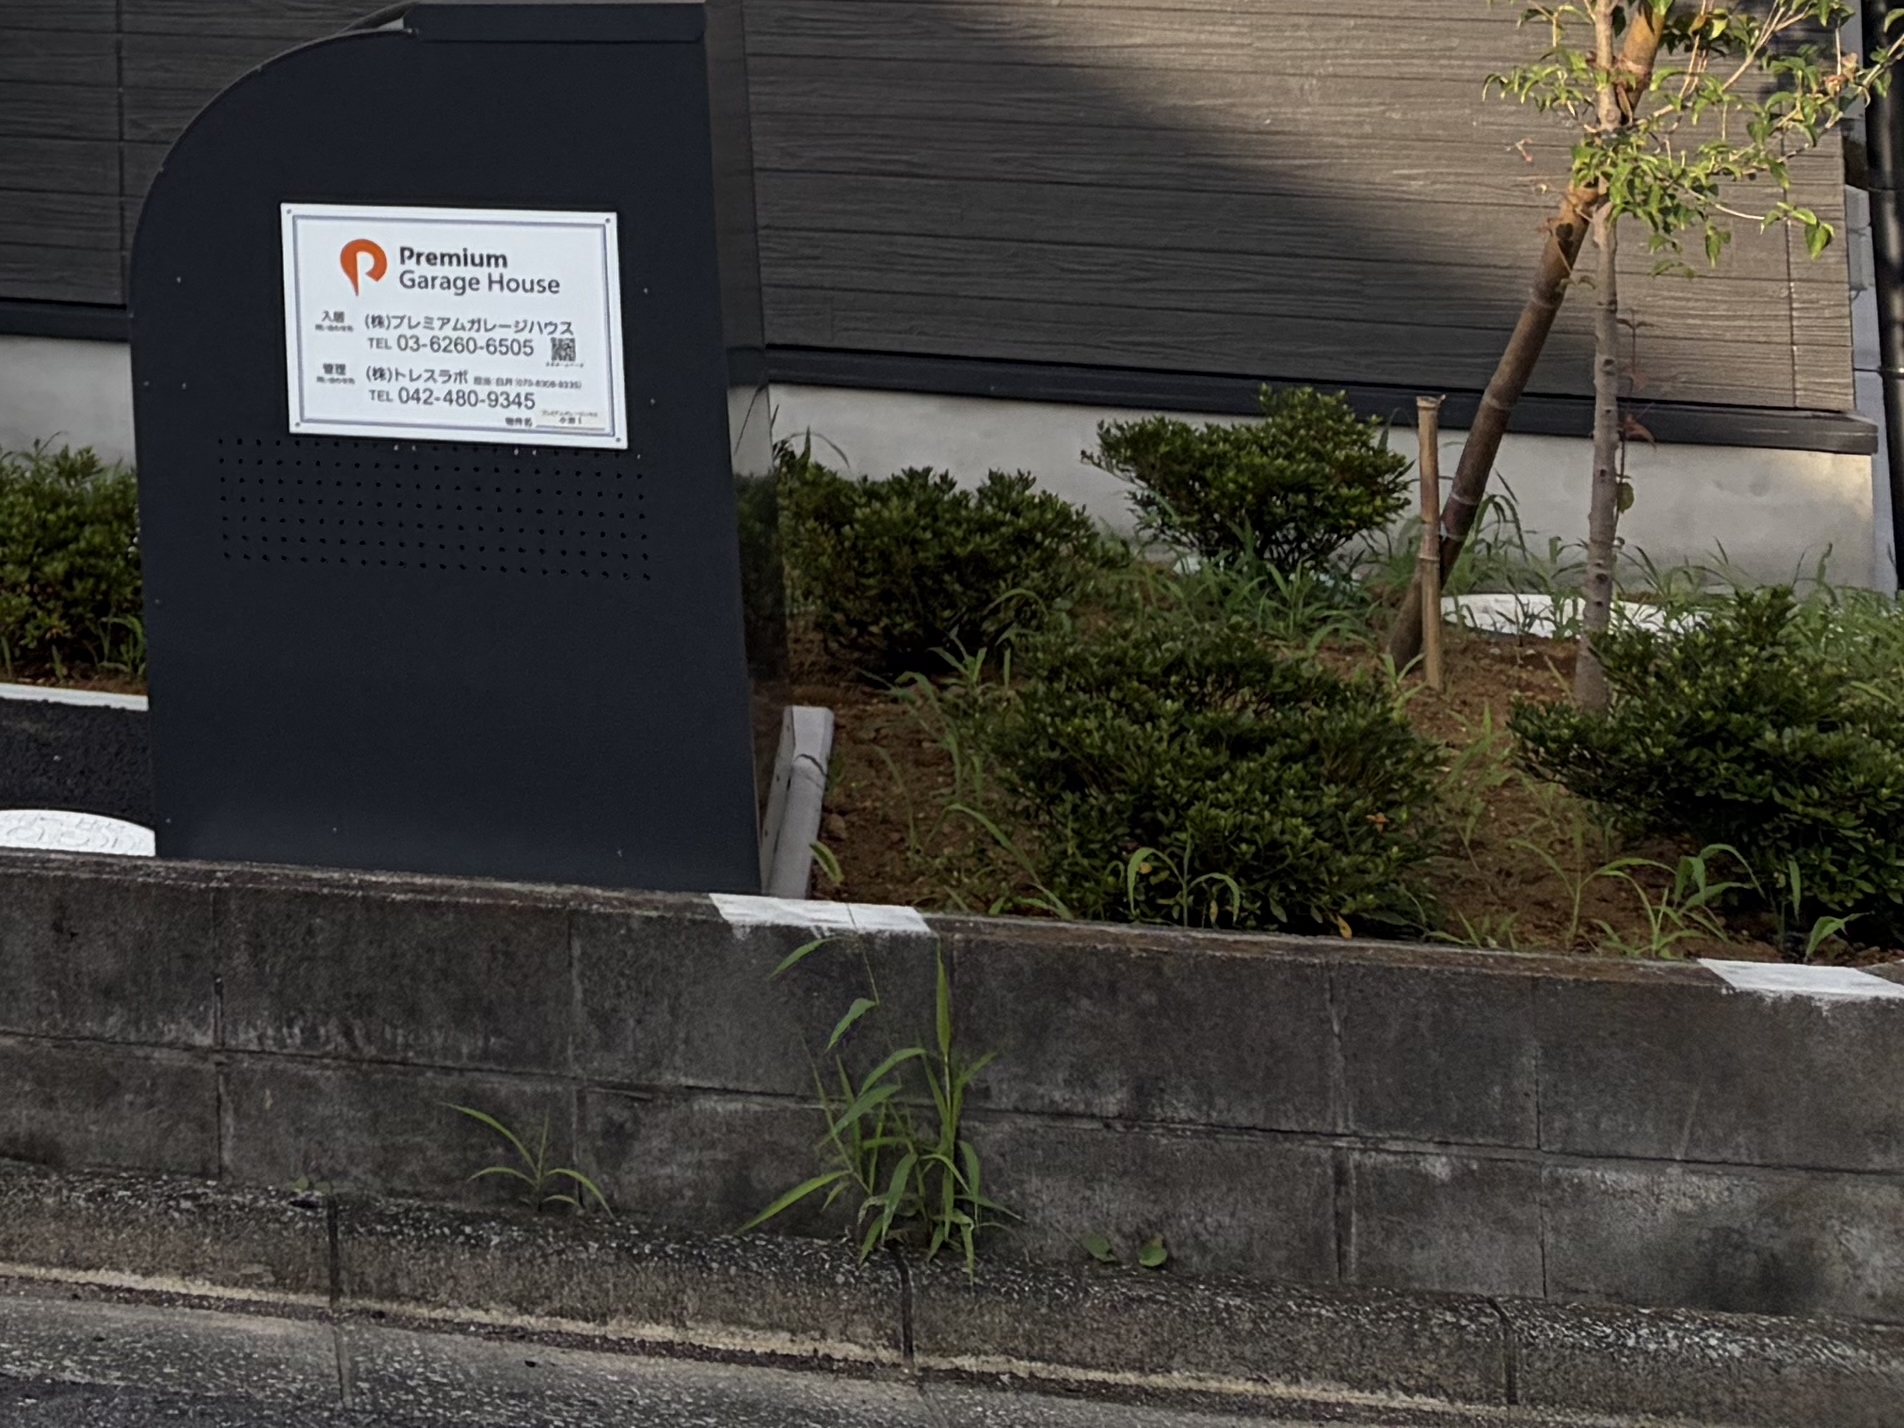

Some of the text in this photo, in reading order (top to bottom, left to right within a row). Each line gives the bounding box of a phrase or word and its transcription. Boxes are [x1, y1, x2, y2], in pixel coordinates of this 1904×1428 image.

[399, 246, 508, 270] Premium
[399, 271, 561, 296] Garage House
[321, 310, 345, 323] 入居
[364, 313, 574, 336] (株)プレミアムガレージハウス
[367, 334, 535, 357] TEL 03-6260-6505
[322, 362, 347, 375] 管理
[365, 365, 469, 385] (株)トレスラボ
[369, 386, 536, 411] TEL 042-480-9345
